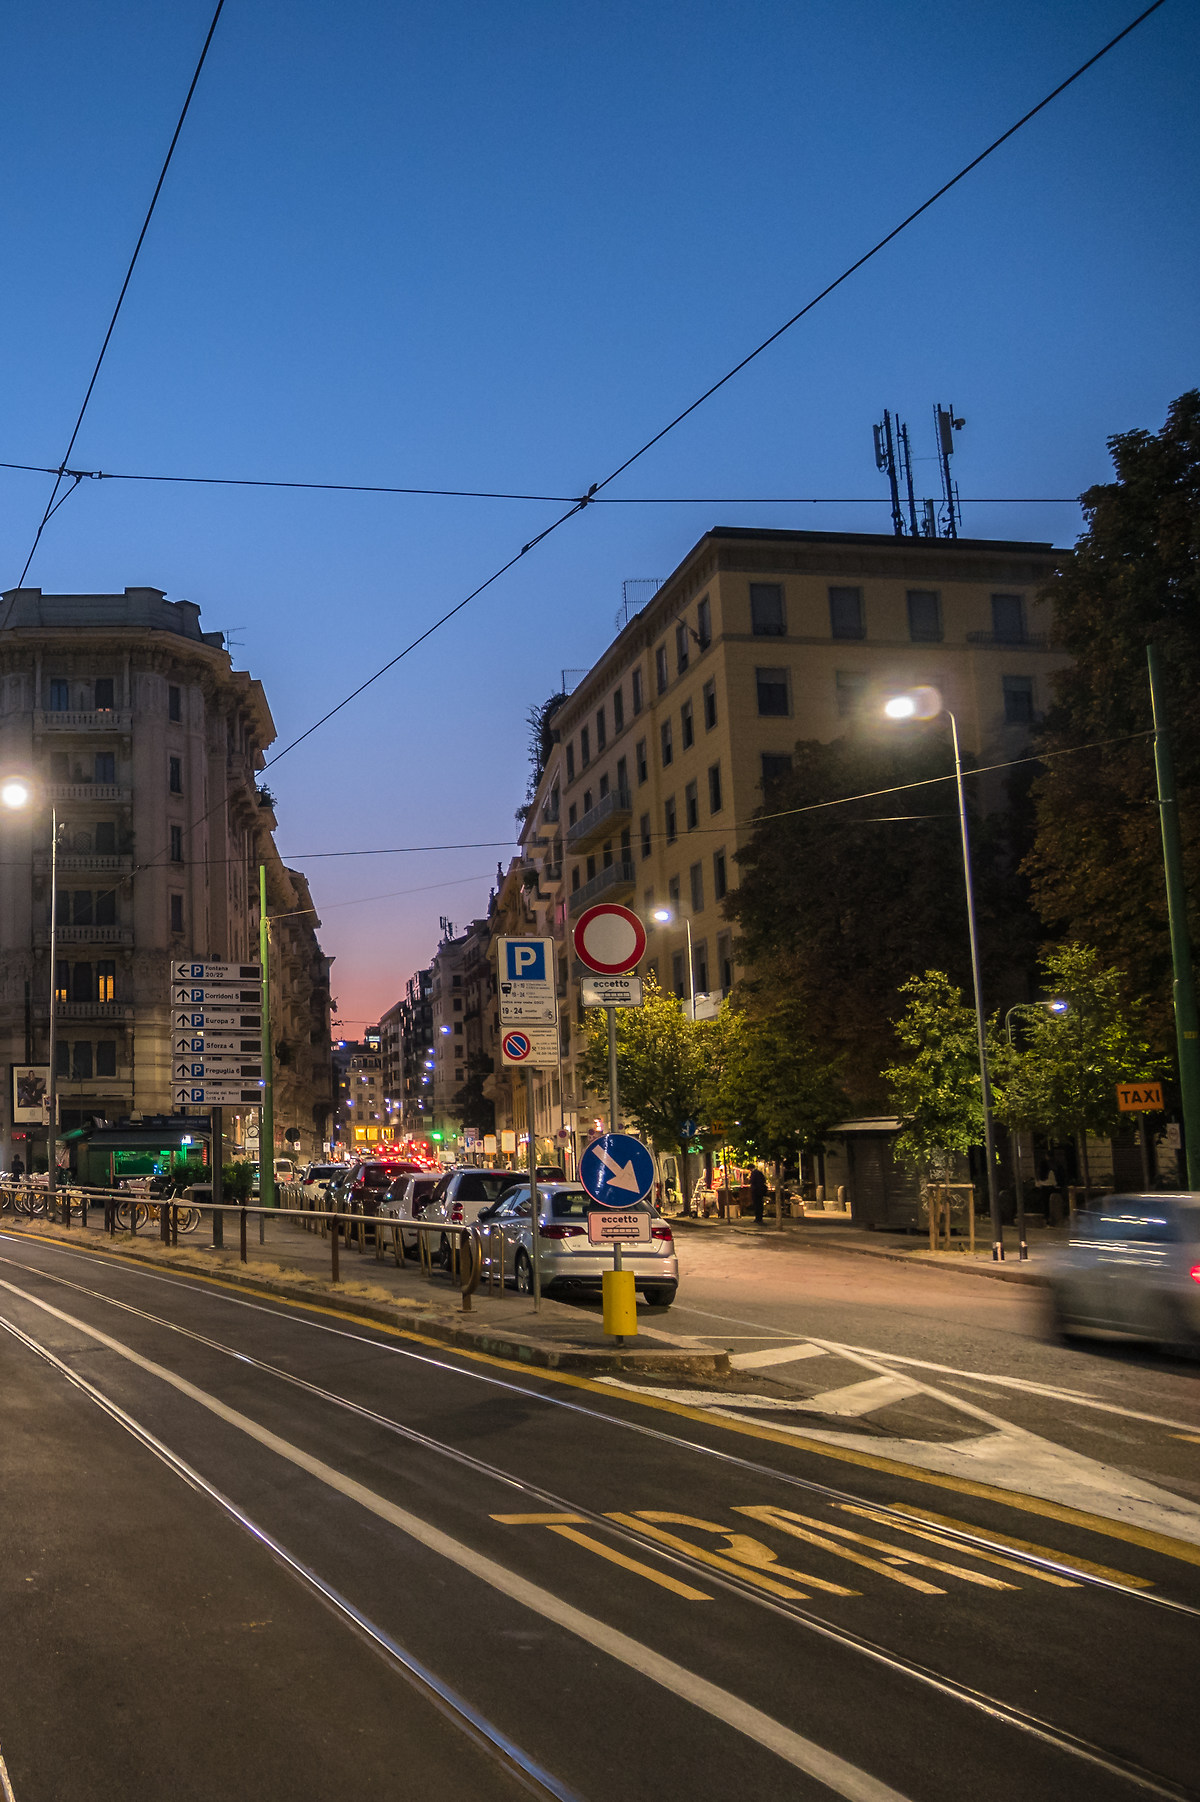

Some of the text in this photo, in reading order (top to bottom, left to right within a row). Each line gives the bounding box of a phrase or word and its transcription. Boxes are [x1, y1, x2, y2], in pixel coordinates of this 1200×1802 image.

[514, 946, 537, 976] P
[194, 966, 202, 976] P
[593, 980, 630, 988] eccetto
[194, 990, 202, 1001] P
[194, 1016, 202, 1025] P
[194, 1041, 202, 1050] P
[194, 1066, 202, 1075] P
[194, 1090, 202, 1100] P
[1121, 1089, 1161, 1105] TAXI
[601, 1215, 638, 1223] eccetto
[488, 1502, 1155, 1602] TRAM
